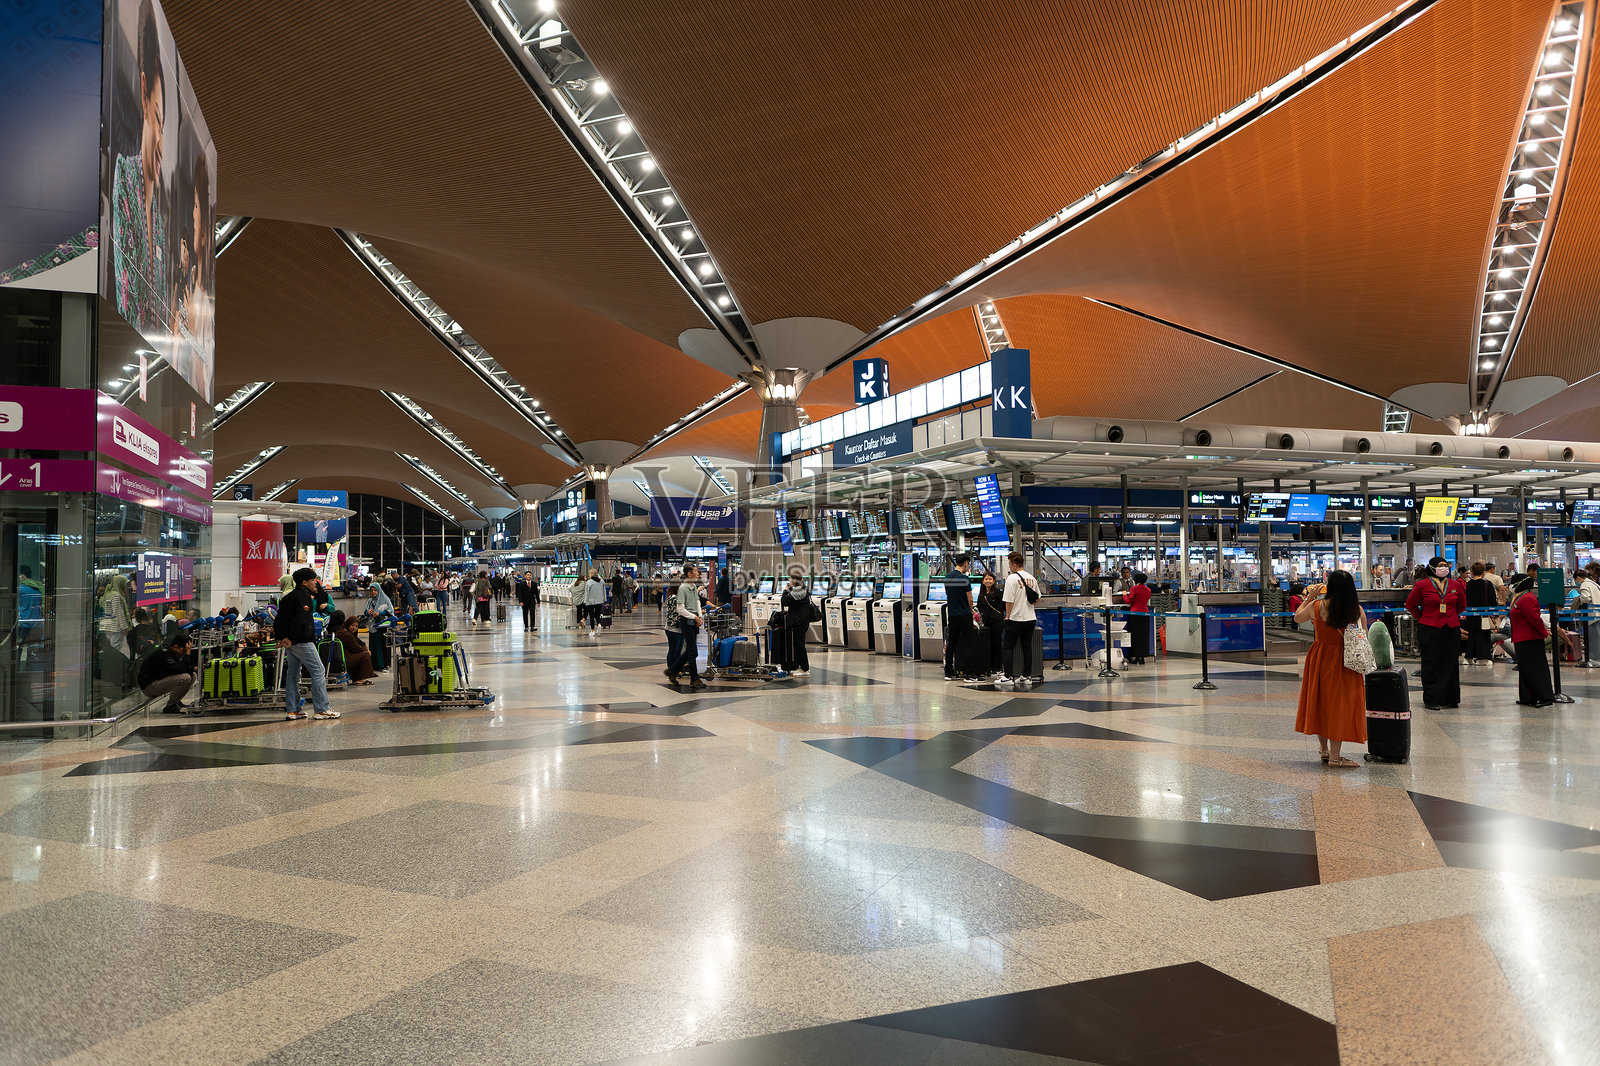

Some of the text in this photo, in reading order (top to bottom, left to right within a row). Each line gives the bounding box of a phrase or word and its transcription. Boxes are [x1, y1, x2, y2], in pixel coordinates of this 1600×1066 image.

[861, 363, 874, 380] J
[883, 364, 888, 380] J
[860, 381, 877, 398] K
[883, 381, 889, 397] K
[1010, 385, 1027, 409] K
[994, 387, 1005, 411] K
[128, 431, 158, 460] KLIA ekspres
[844, 432, 897, 456] Kaunter Daftar Masuk
[854, 451, 887, 464] Check-in Counters
[29, 462, 41, 488] 1
[1231, 495, 1241, 505] K1
[1353, 498, 1364, 507] K2
[1404, 499, 1414, 508] K3
[1555, 501, 1565, 510] K5
[589, 511, 597, 521] H
[680, 509, 721, 519] malaysia
[1000, 498, 1015, 524] K
[145, 560, 161, 579] Tell us
